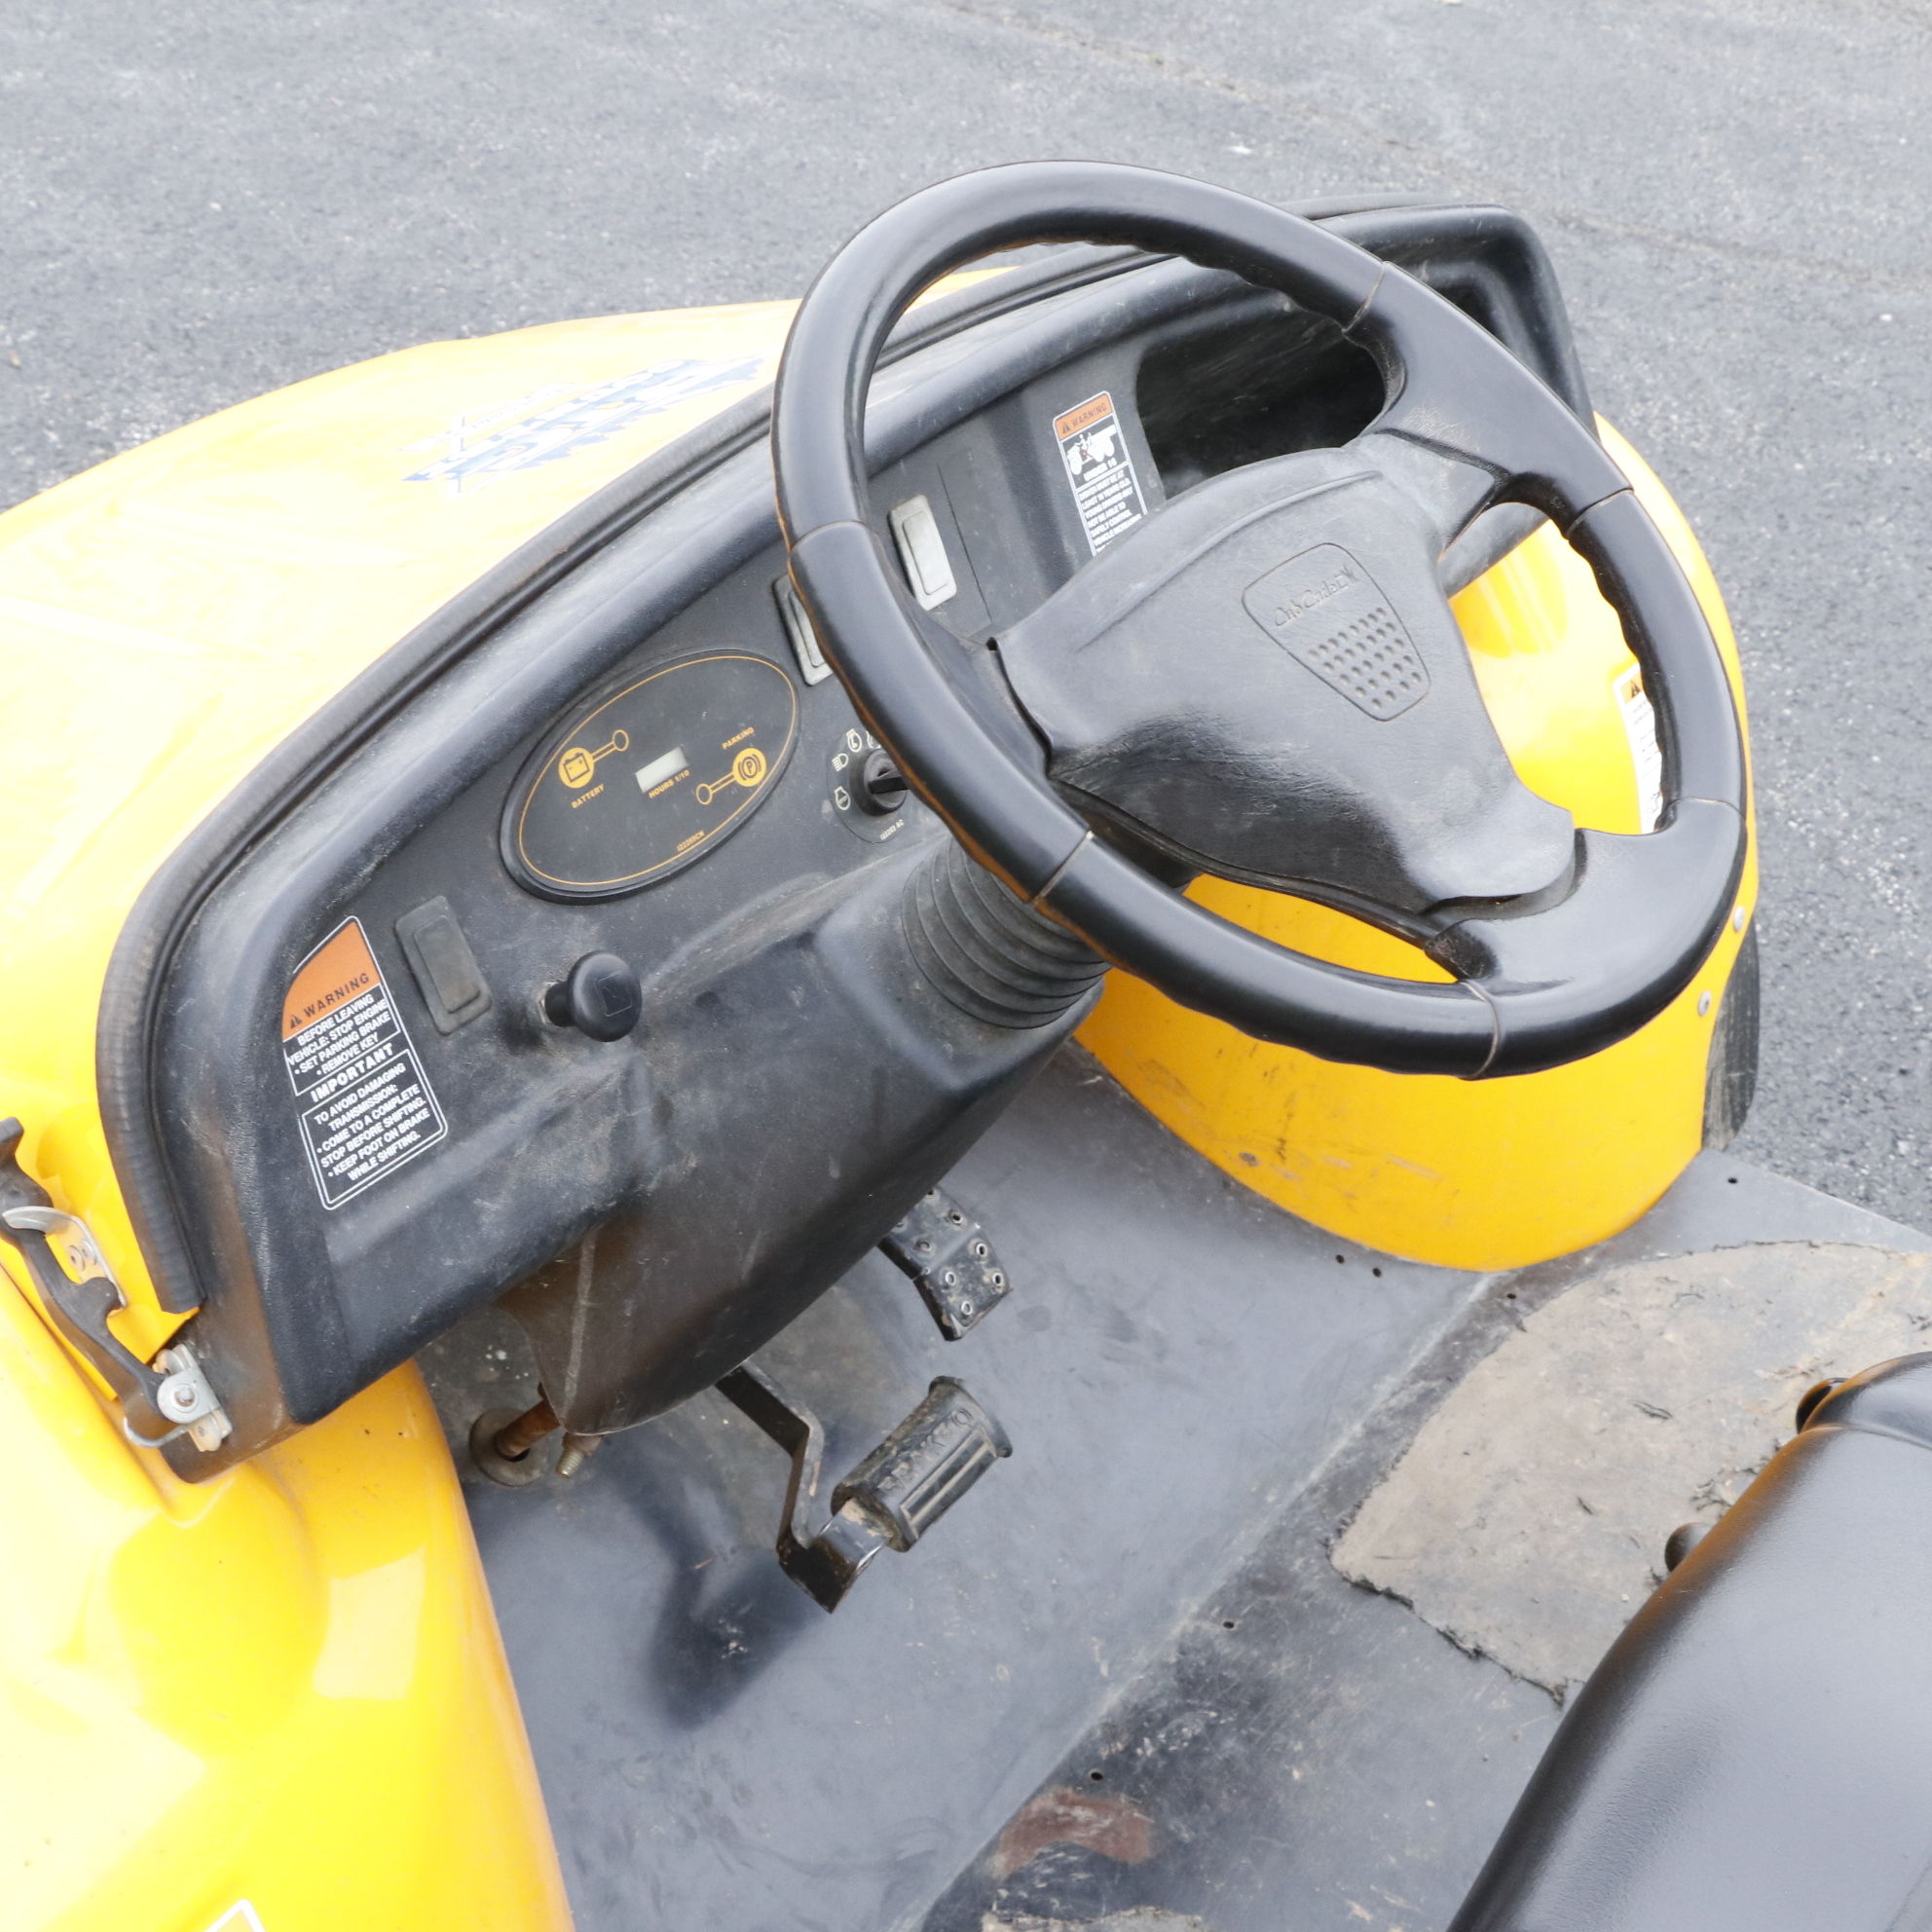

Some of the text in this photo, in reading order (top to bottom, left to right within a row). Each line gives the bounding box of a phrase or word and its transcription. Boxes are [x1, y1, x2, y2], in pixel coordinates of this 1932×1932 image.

[1071, 402, 1108, 427] WARNING
[1081, 496, 1098, 510] LEAST
[1102, 483, 1121, 498] YEARS
[1083, 463, 1108, 482] UNDER
[1109, 473, 1118, 484] BE
[722, 726, 755, 750] PARKING
[571, 784, 605, 809] BATTERY
[649, 779, 675, 799] HOURS
[303, 973, 369, 1018] WARNING
[287, 998, 388, 1065] VEHICLE: STOP ENGINE
[297, 994, 374, 1046] BEFORE LEAVING
[299, 1011, 391, 1073] SET PARKING BRAKE
[311, 1043, 393, 1102] IMPORTANT
[321, 1032, 379, 1074] REMOVE KEY
[314, 1062, 406, 1125] TO AVOID DAMAGING
[321, 1083, 421, 1151] COME TO A COMPLETE
[328, 1084, 398, 1132] TRANSMISSION:
[320, 1096, 427, 1168] STOP BEFORE SHIFTING.
[332, 1107, 430, 1175] KEEP FOOT ON BRAKE
[347, 1131, 422, 1181] WHILE SHIFTING.
